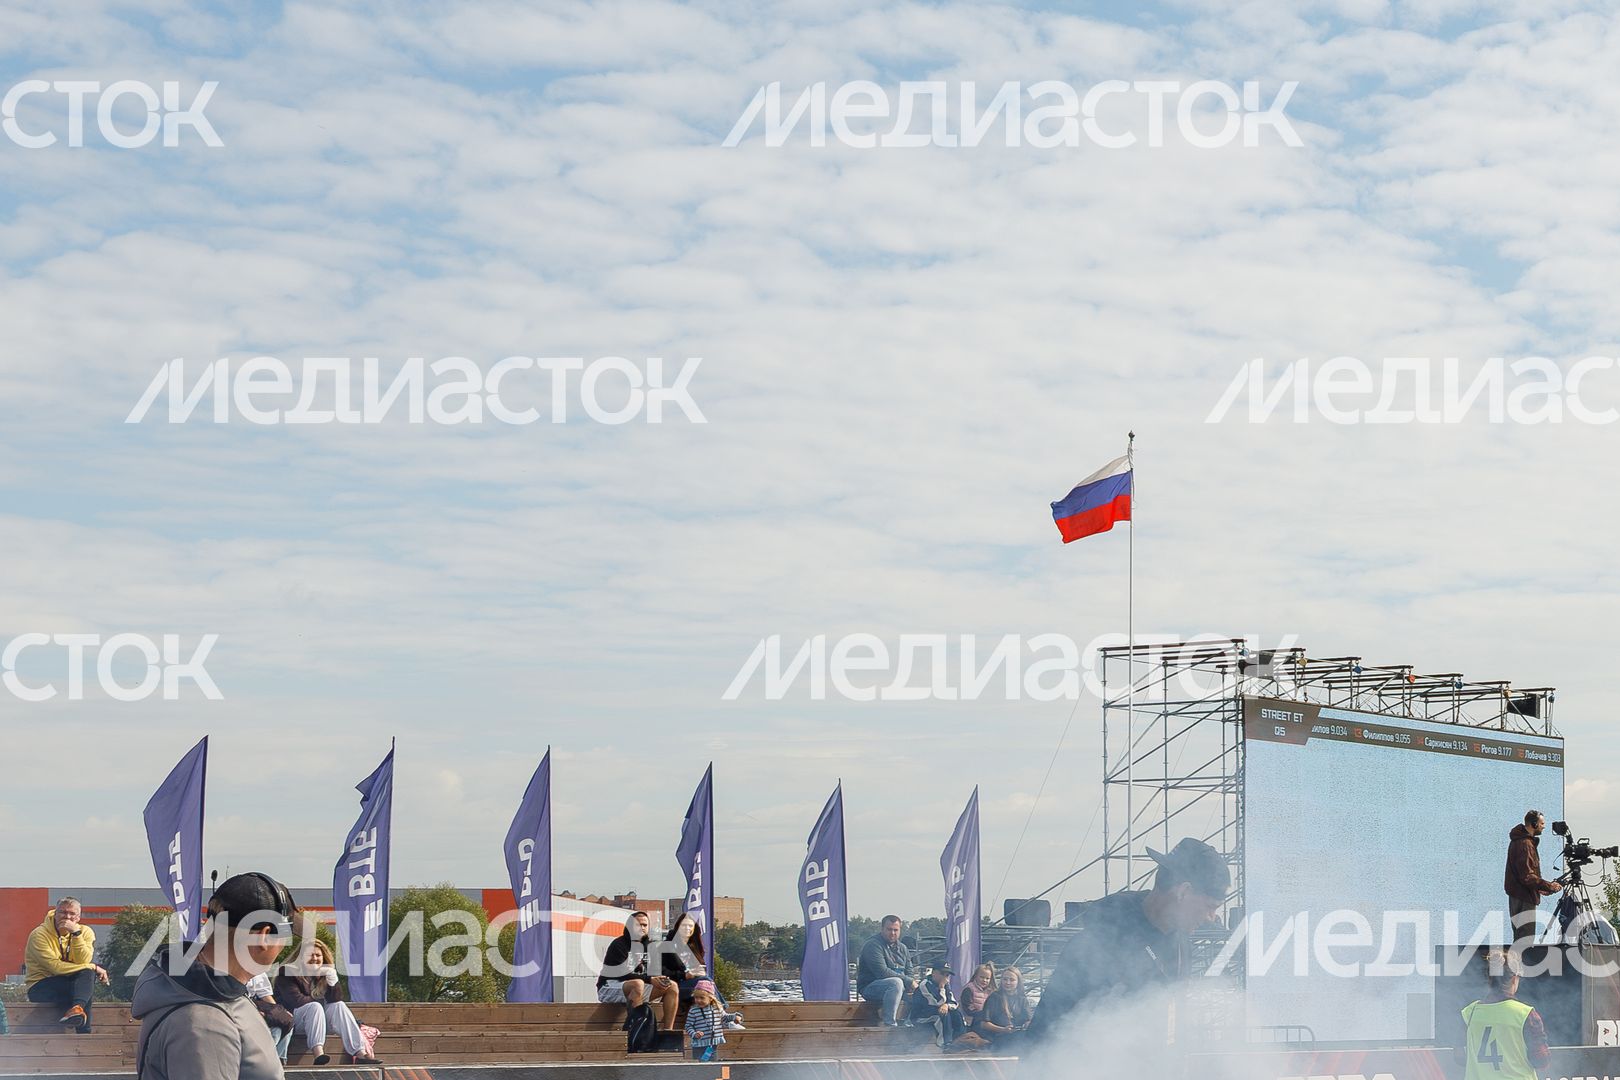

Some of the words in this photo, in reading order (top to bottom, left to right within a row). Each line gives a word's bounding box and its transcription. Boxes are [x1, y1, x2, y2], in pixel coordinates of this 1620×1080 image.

[1261, 708, 1292, 722] STREET
[1293, 713, 1304, 723] ET
[1330, 726, 1348, 736] 9.034
[1363, 729, 1394, 742] Филиппов
[1395, 732, 1411, 744] 9.055
[1424, 737, 1452, 750] Саркисян
[1452, 740, 1468, 751] 9.134
[1481, 744, 1498, 756] Рогов
[1498, 746, 1512, 757] 9.177
[1524, 750, 1548, 762] Лобачев
[1548, 752, 1561, 763] 9.303
[1477, 1026, 1503, 1071] 4
